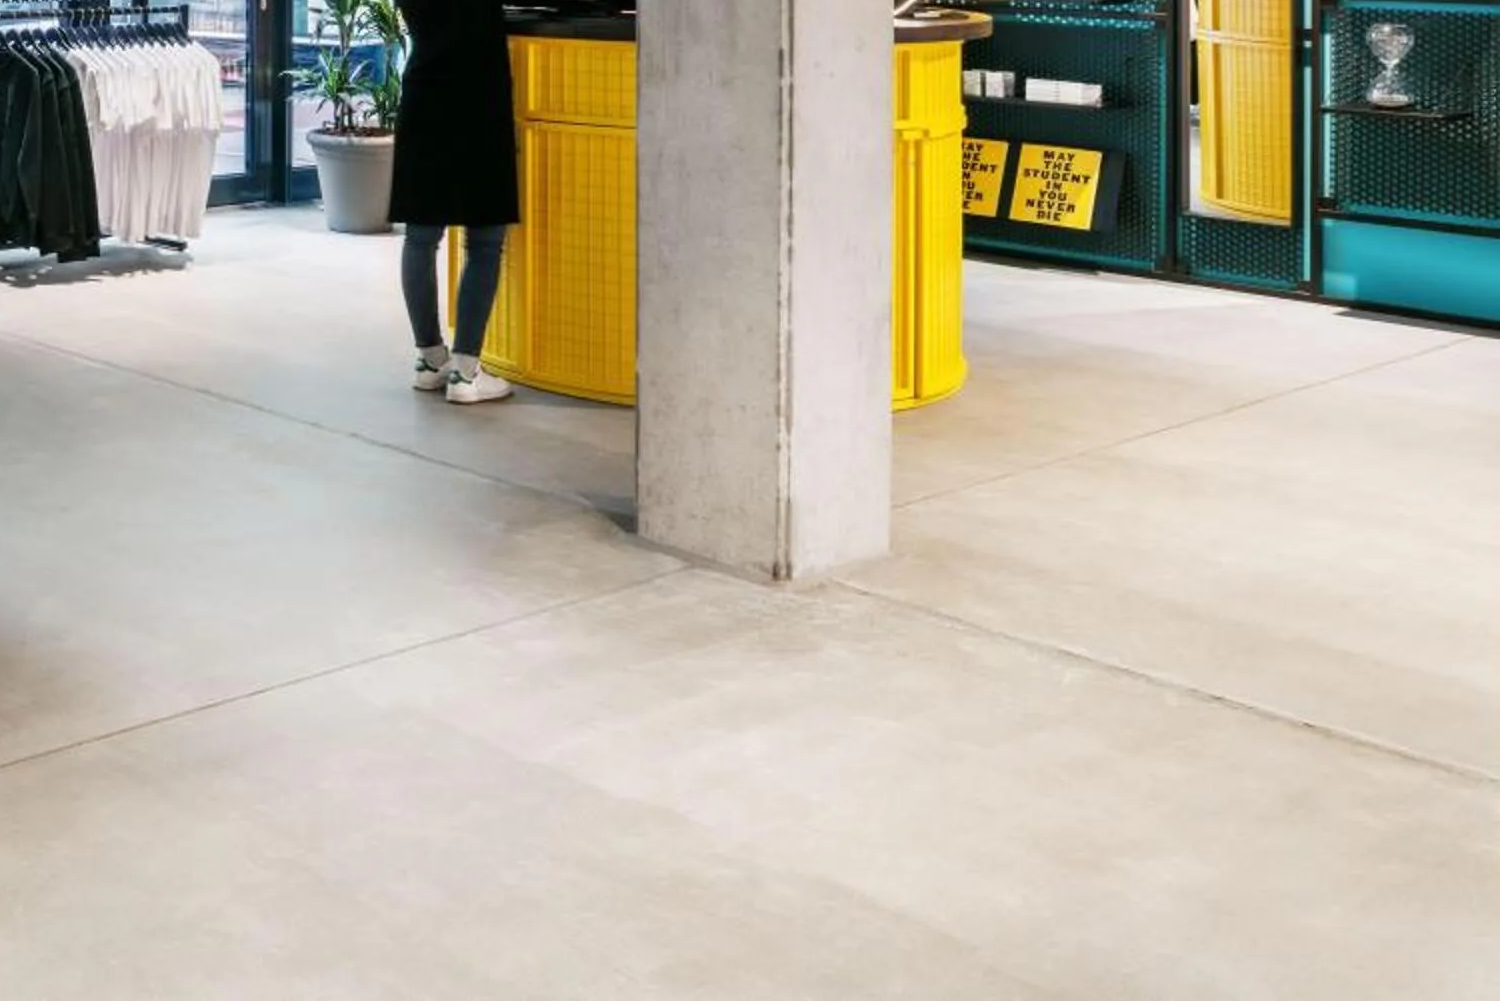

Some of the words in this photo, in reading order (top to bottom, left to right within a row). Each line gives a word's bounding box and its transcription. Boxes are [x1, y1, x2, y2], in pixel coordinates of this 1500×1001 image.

[1043, 150, 1074, 161] MAY
[1044, 161, 1072, 171] THE
[1023, 168, 1091, 184] STUDENT
[1046, 181, 1062, 190] IN
[1039, 190, 1067, 201] YOU
[1026, 199, 1076, 213] NEVER
[1037, 210, 1062, 221] DIE
